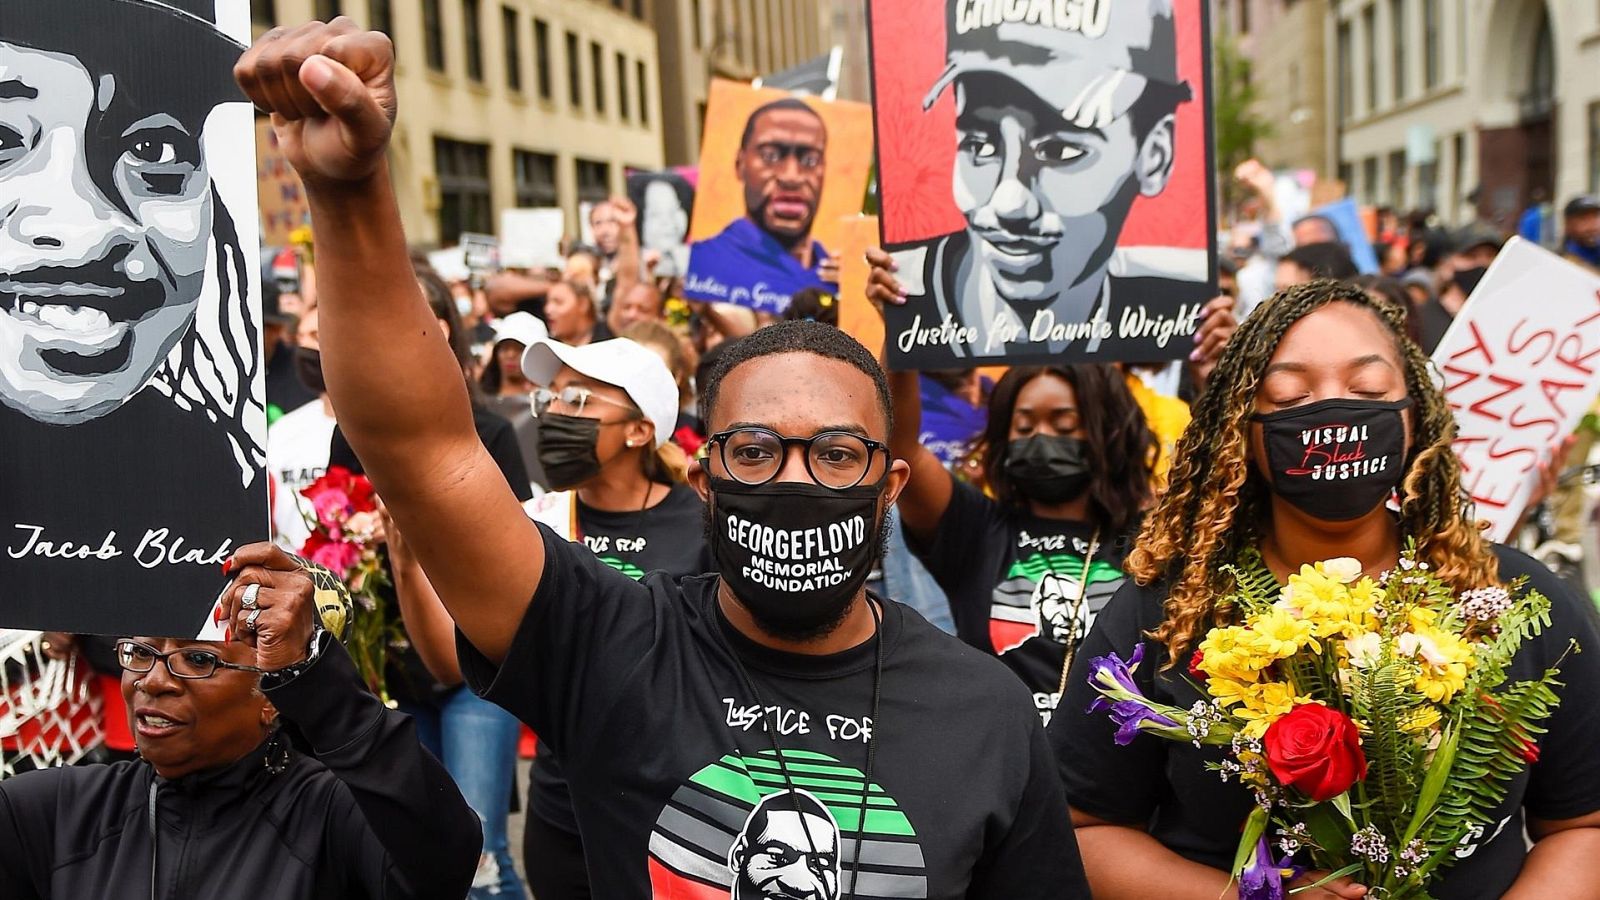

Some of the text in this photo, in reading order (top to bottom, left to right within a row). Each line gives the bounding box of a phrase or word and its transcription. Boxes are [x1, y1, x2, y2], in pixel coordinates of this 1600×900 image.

[897, 302, 1202, 353] Justice for Daunte Wright
[1301, 424, 1369, 445] VISUAL
[1285, 424, 1367, 475] Black
[1311, 455, 1388, 480] JUSTICE
[7, 523, 233, 569] Jacob Blak
[742, 566, 853, 592] FOUNDATION
[751, 554, 845, 578] MEMORIAL
